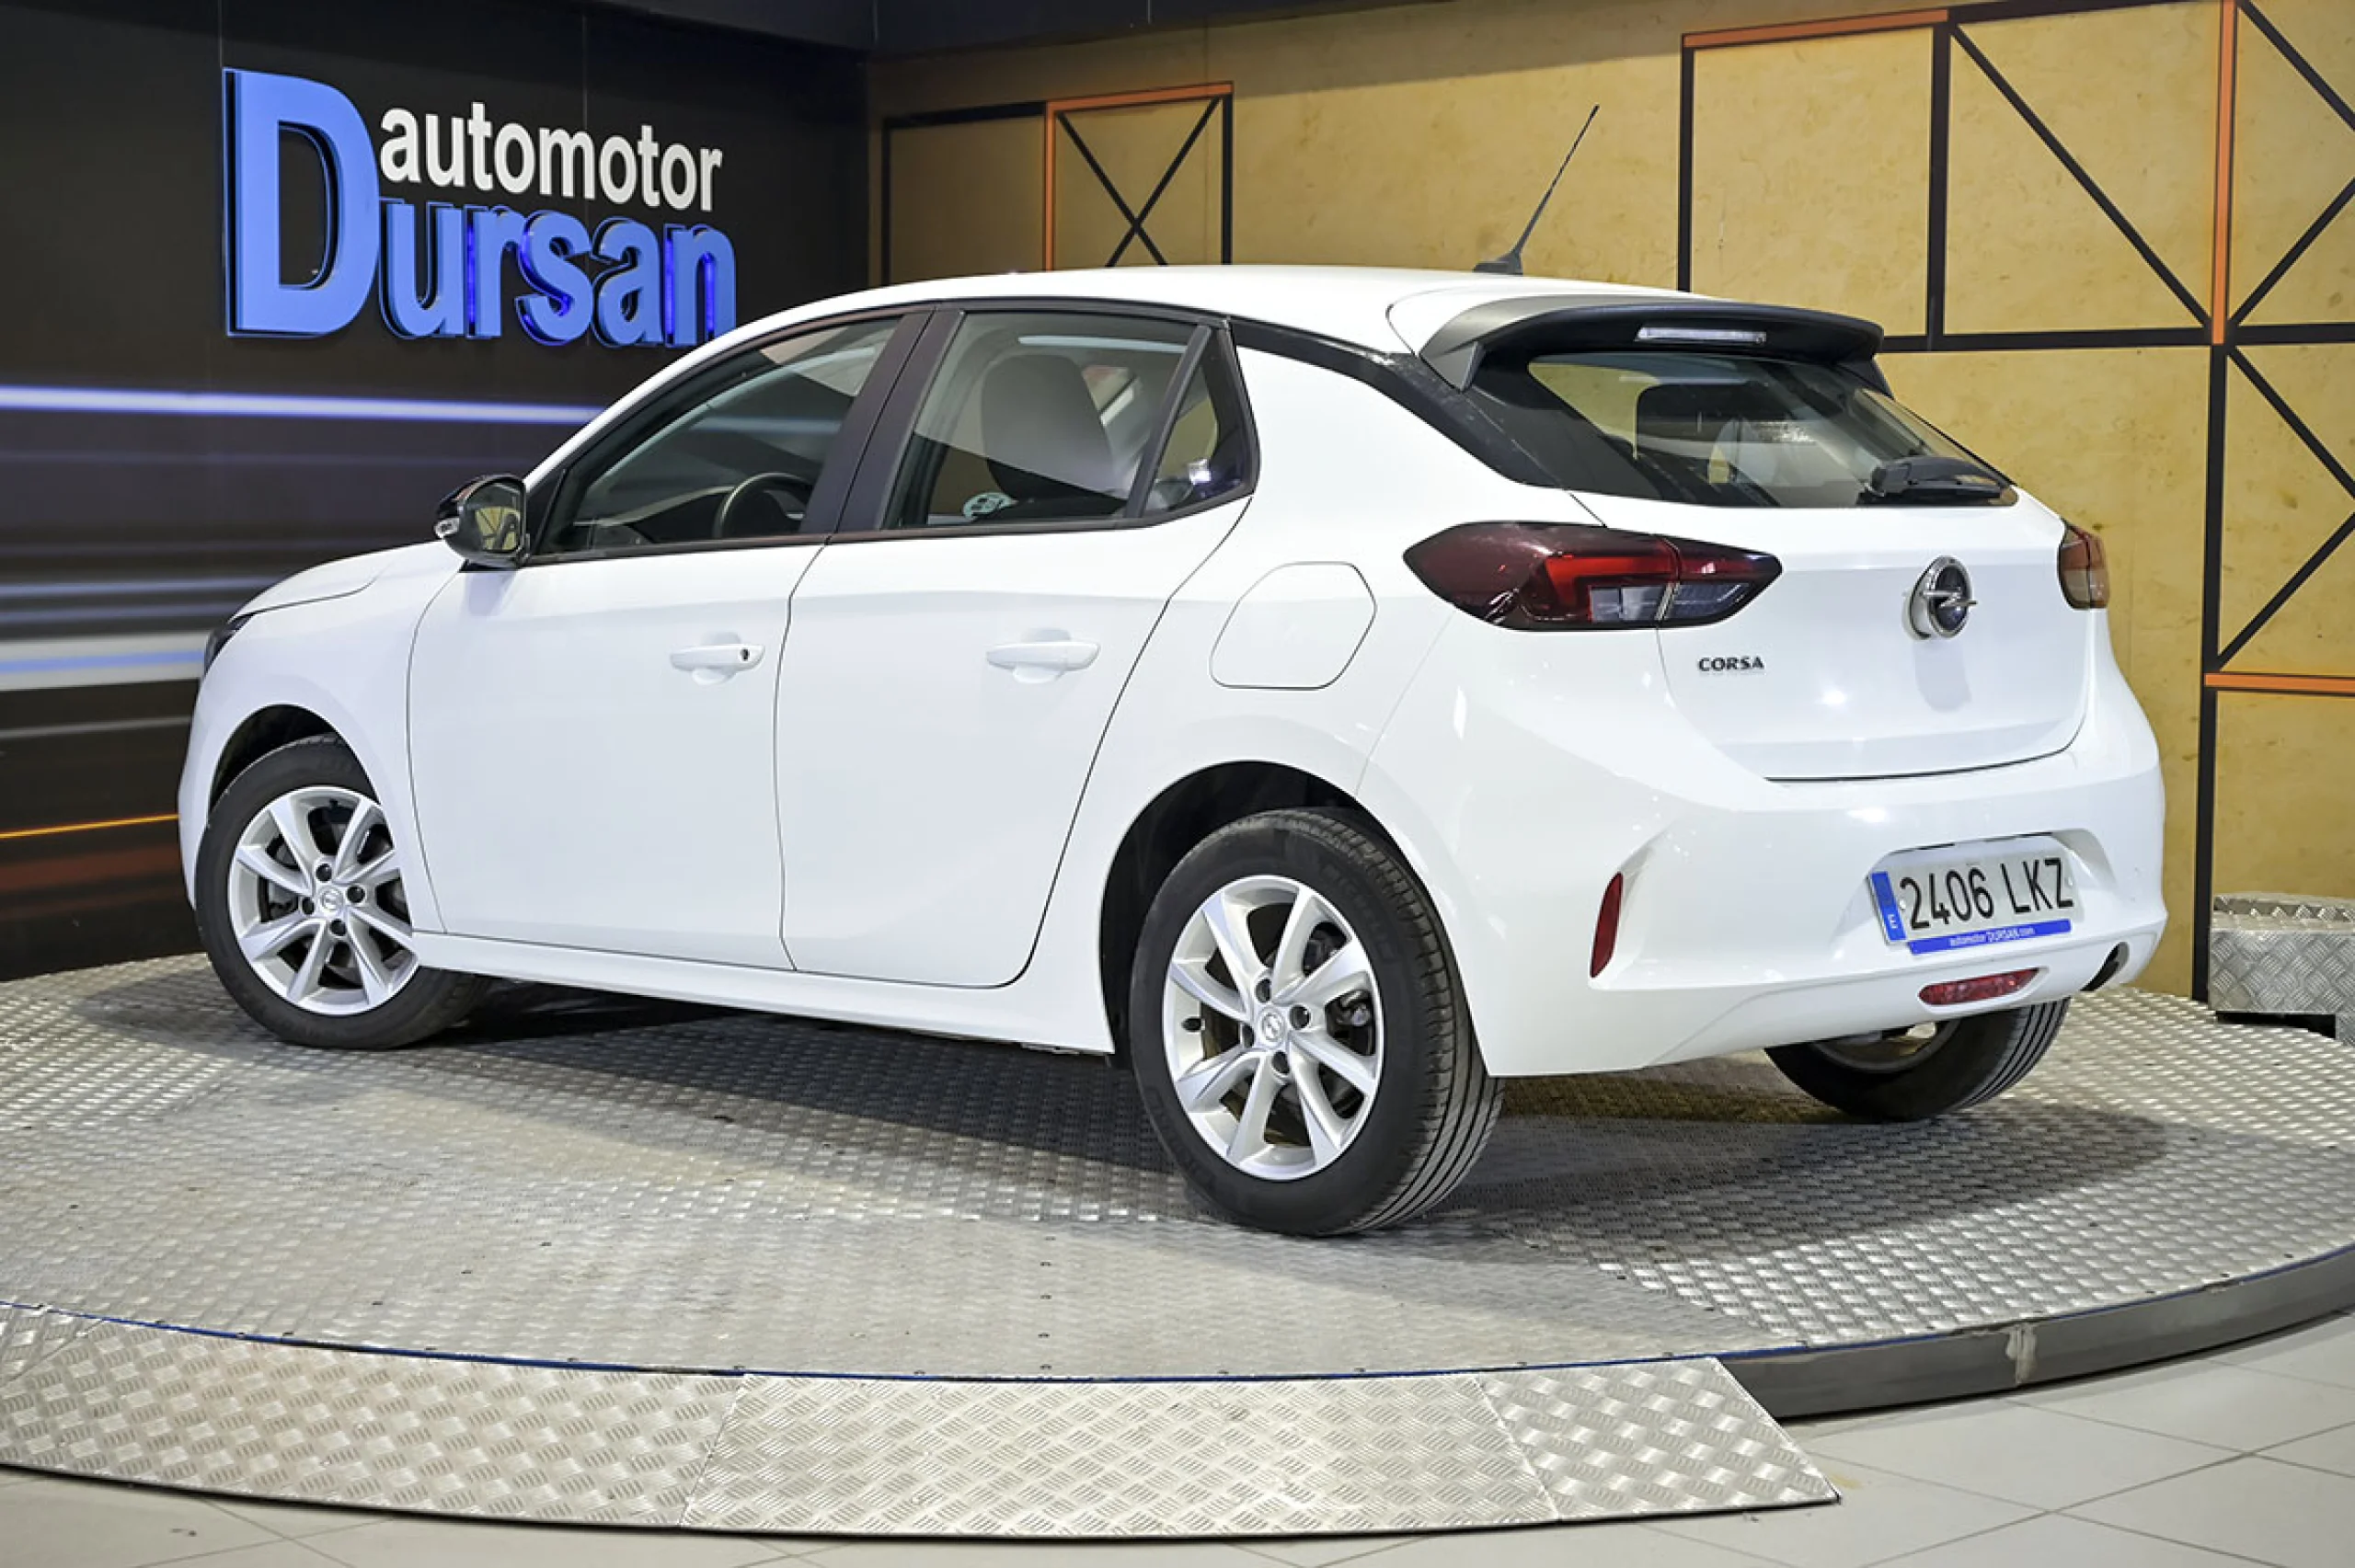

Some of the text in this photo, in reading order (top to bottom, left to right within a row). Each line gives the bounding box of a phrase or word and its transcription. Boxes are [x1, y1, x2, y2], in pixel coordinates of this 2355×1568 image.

[379, 102, 723, 212] automotor
[223, 66, 737, 347] Dursan
[1698, 656, 1764, 672] CORSA
[1900, 857, 2074, 930] 2406 LKZ
